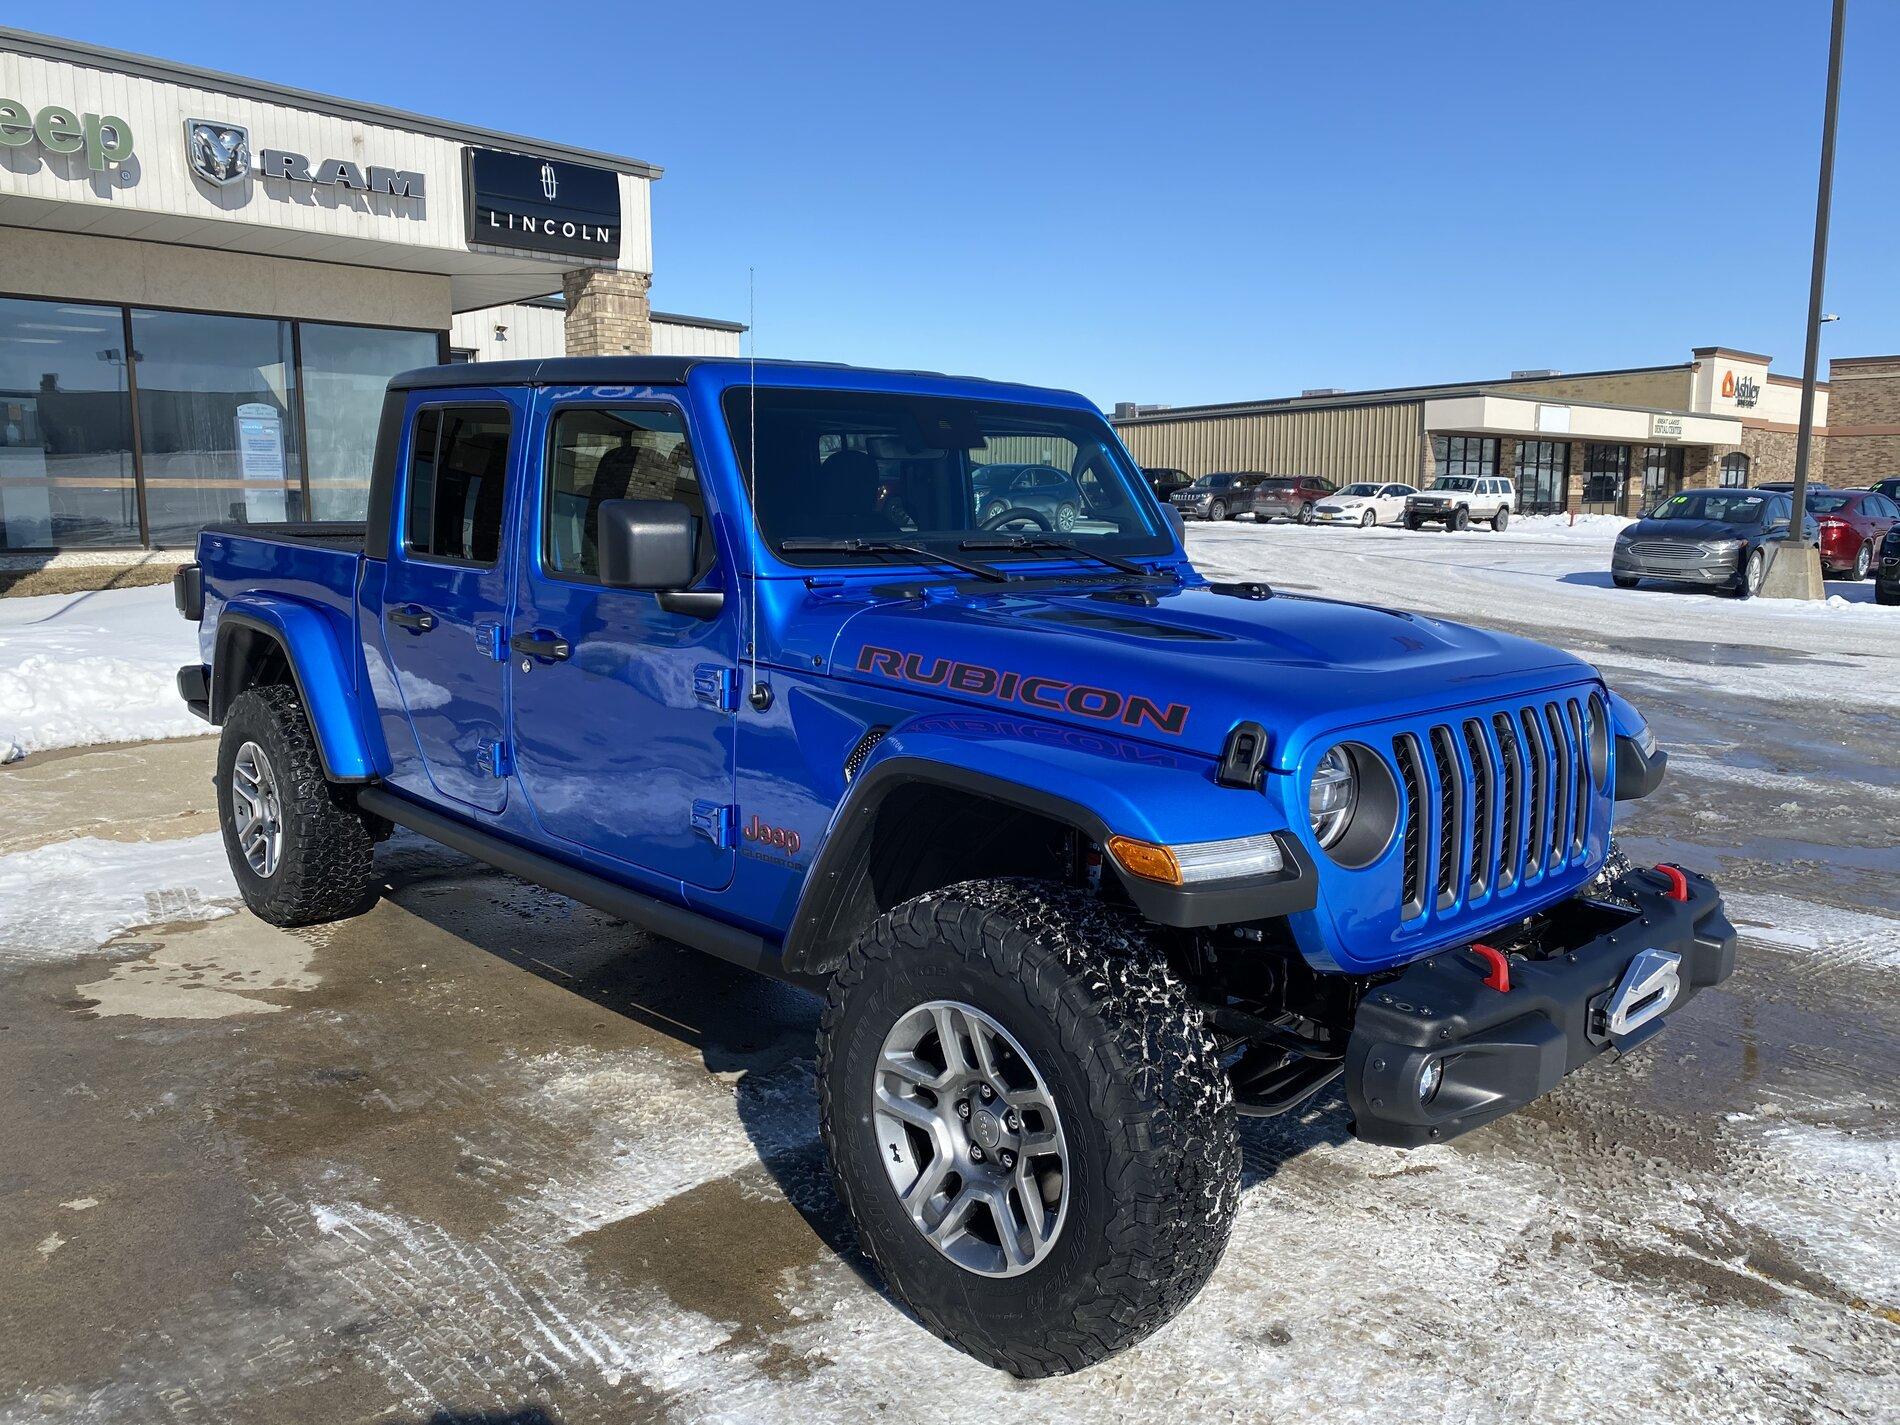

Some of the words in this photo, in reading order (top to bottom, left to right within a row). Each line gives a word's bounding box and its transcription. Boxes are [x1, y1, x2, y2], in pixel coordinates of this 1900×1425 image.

[260, 149, 426, 198] RAM
[490, 211, 609, 243] LINCOLN
[1733, 376, 1760, 405] Ashley
[856, 645, 1191, 736] RUBICON
[743, 814, 801, 857] Jeep
